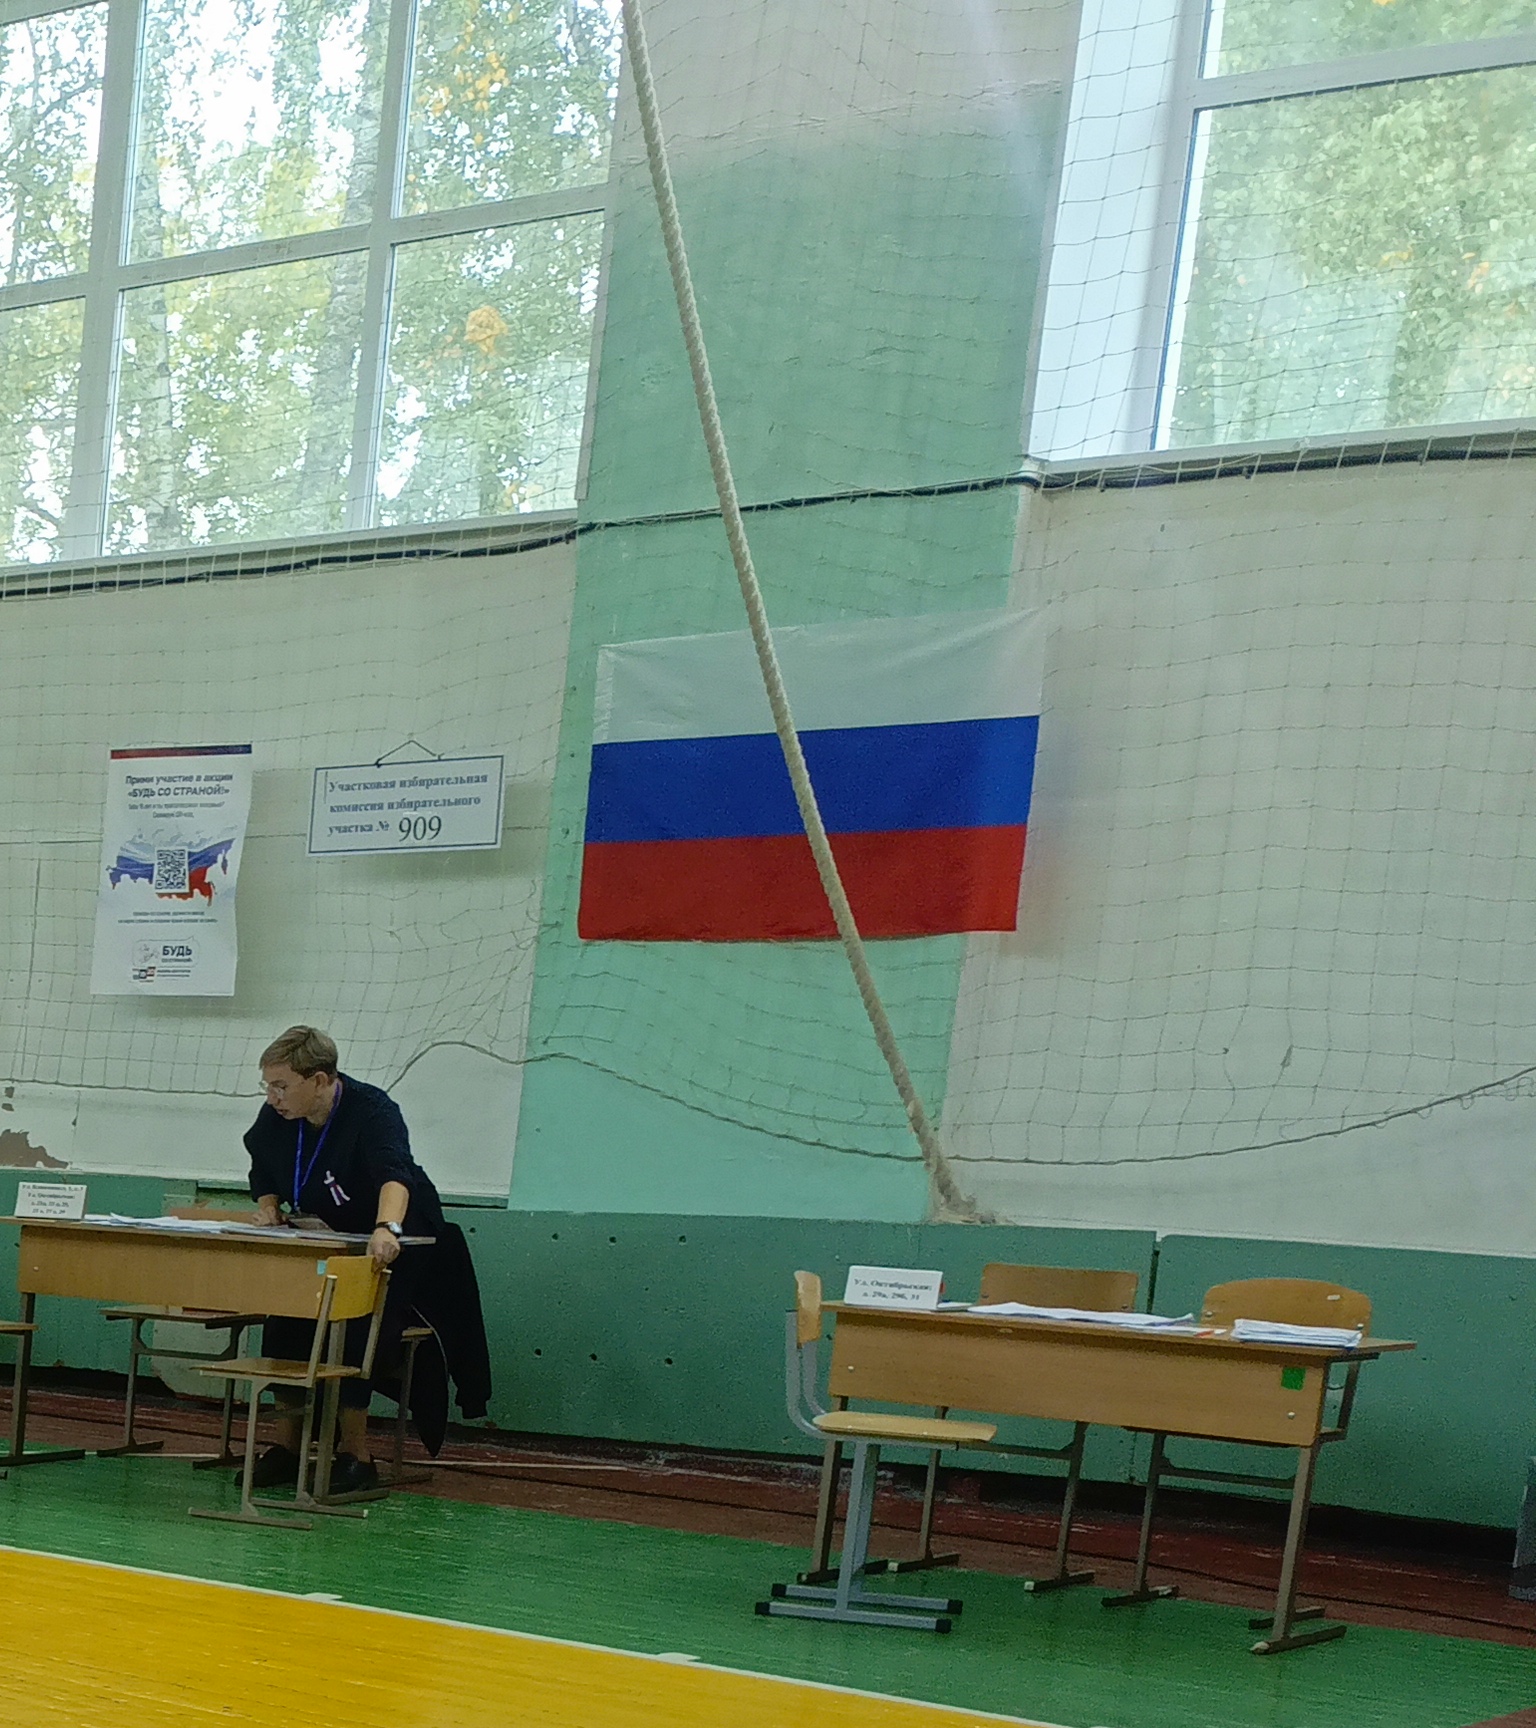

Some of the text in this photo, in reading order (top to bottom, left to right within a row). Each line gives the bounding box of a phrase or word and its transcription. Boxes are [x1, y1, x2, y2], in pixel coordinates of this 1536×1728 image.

[156, 775, 194, 785] участие
[328, 774, 488, 793] Участковая избирательная
[157, 787, 171, 796] СО
[330, 796, 481, 813] комиссия избирательного
[328, 823, 374, 837] участка
[398, 815, 442, 842] 909
[162, 945, 192, 957] БУДЬ
